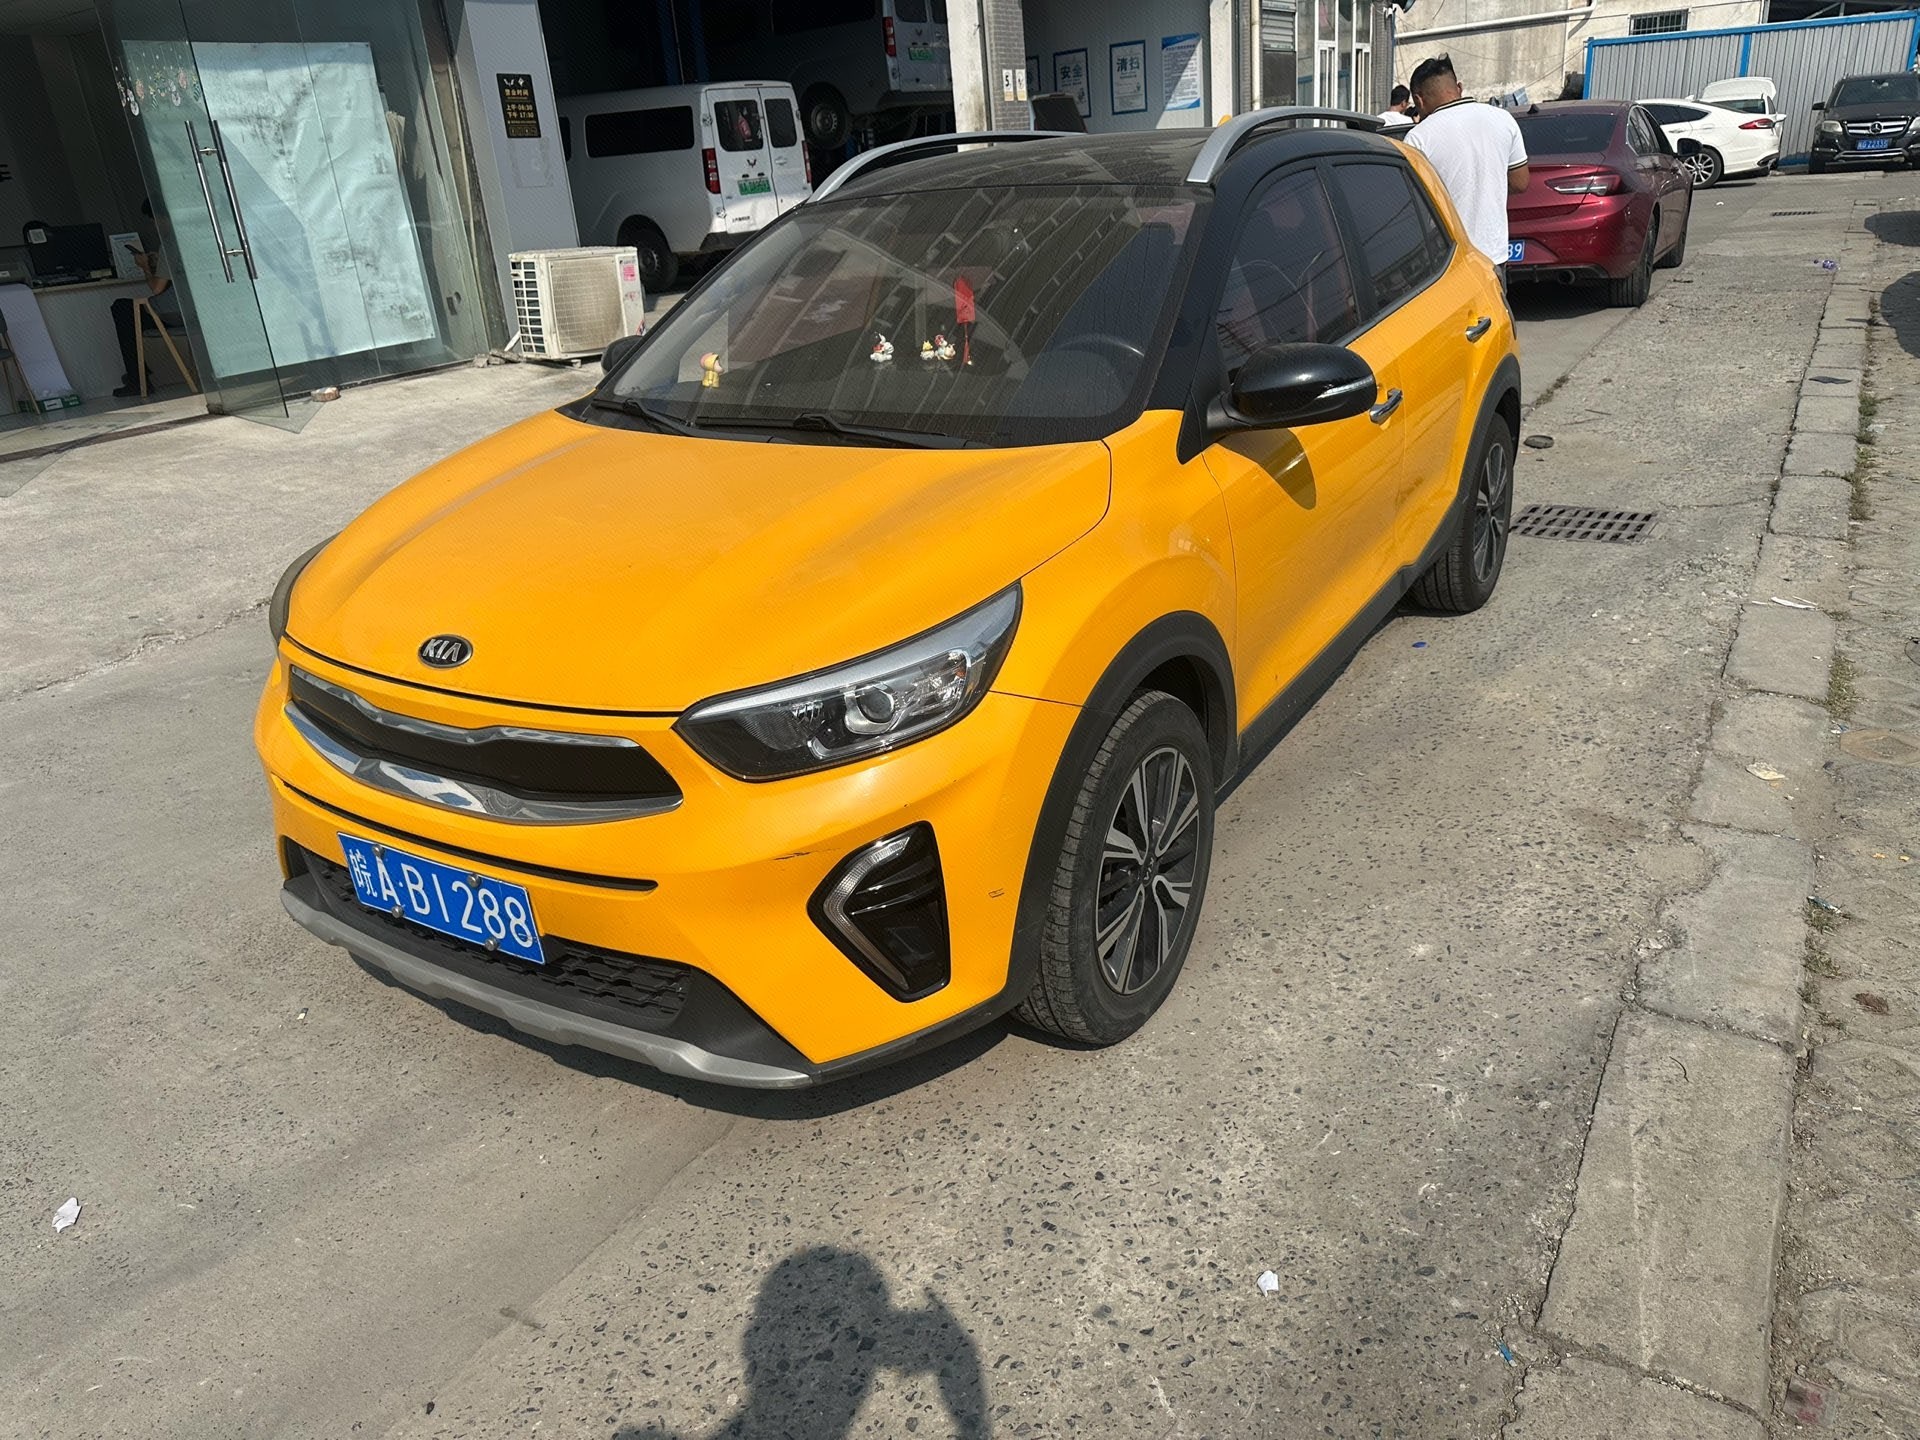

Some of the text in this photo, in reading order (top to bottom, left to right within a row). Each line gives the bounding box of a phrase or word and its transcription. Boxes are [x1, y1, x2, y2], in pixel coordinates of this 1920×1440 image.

[1061, 63, 1082, 79] 安全
[1116, 57, 1140, 72] 清扫
[422, 638, 462, 662] KIA
